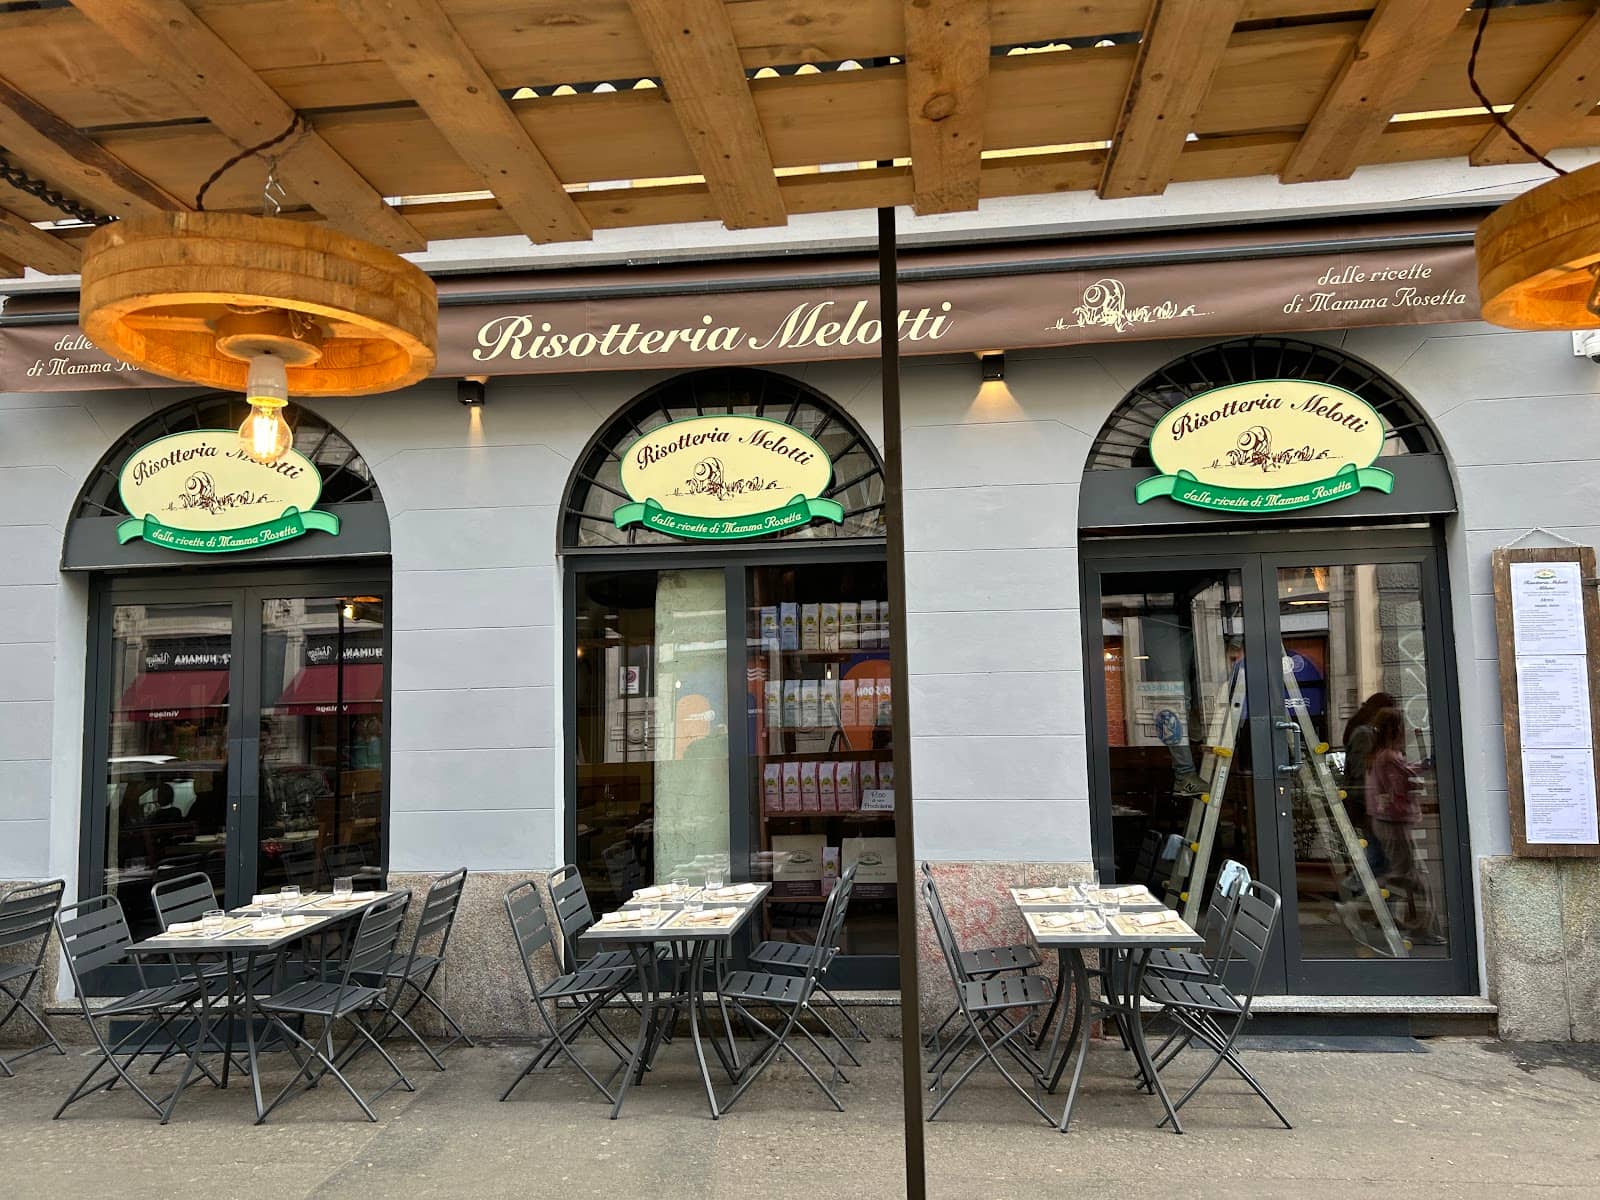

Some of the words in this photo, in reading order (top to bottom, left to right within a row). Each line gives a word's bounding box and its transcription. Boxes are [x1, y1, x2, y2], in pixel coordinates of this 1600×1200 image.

[1317, 265, 1365, 286] dalle
[1369, 263, 1433, 283] ricette
[1283, 294, 1305, 314] di
[1306, 291, 1389, 313] Mamma
[1391, 287, 1467, 308] Rosetta
[54, 334, 93, 351] dalle
[472, 313, 747, 362] Risotteria
[747, 300, 954, 351] Melotti
[26, 359, 45, 377] di
[46, 357, 112, 376] Mamma
[1171, 393, 1283, 442] Risotteria
[1290, 393, 1369, 434] Melotti
[637, 427, 731, 471] Risotteria
[738, 428, 814, 467] Melotti
[133, 442, 219, 487] Risotteria
[1184, 489, 1211, 505] dalle
[1213, 495, 1249, 507] ricette
[1250, 494, 1263, 508] di
[1264, 494, 1310, 508] Mamma
[1311, 480, 1353, 501] Rosetta
[152, 529, 175, 544] dalle
[175, 536, 205, 548] ricette
[206, 536, 216, 548] di
[215, 534, 259, 549] Mamma
[259, 525, 298, 542] Rosetta
[651, 513, 675, 529] dalle
[676, 520, 708, 533] ricette
[708, 522, 720, 534] di
[719, 521, 763, 535] Mamma
[764, 512, 802, 529] Rosetta
